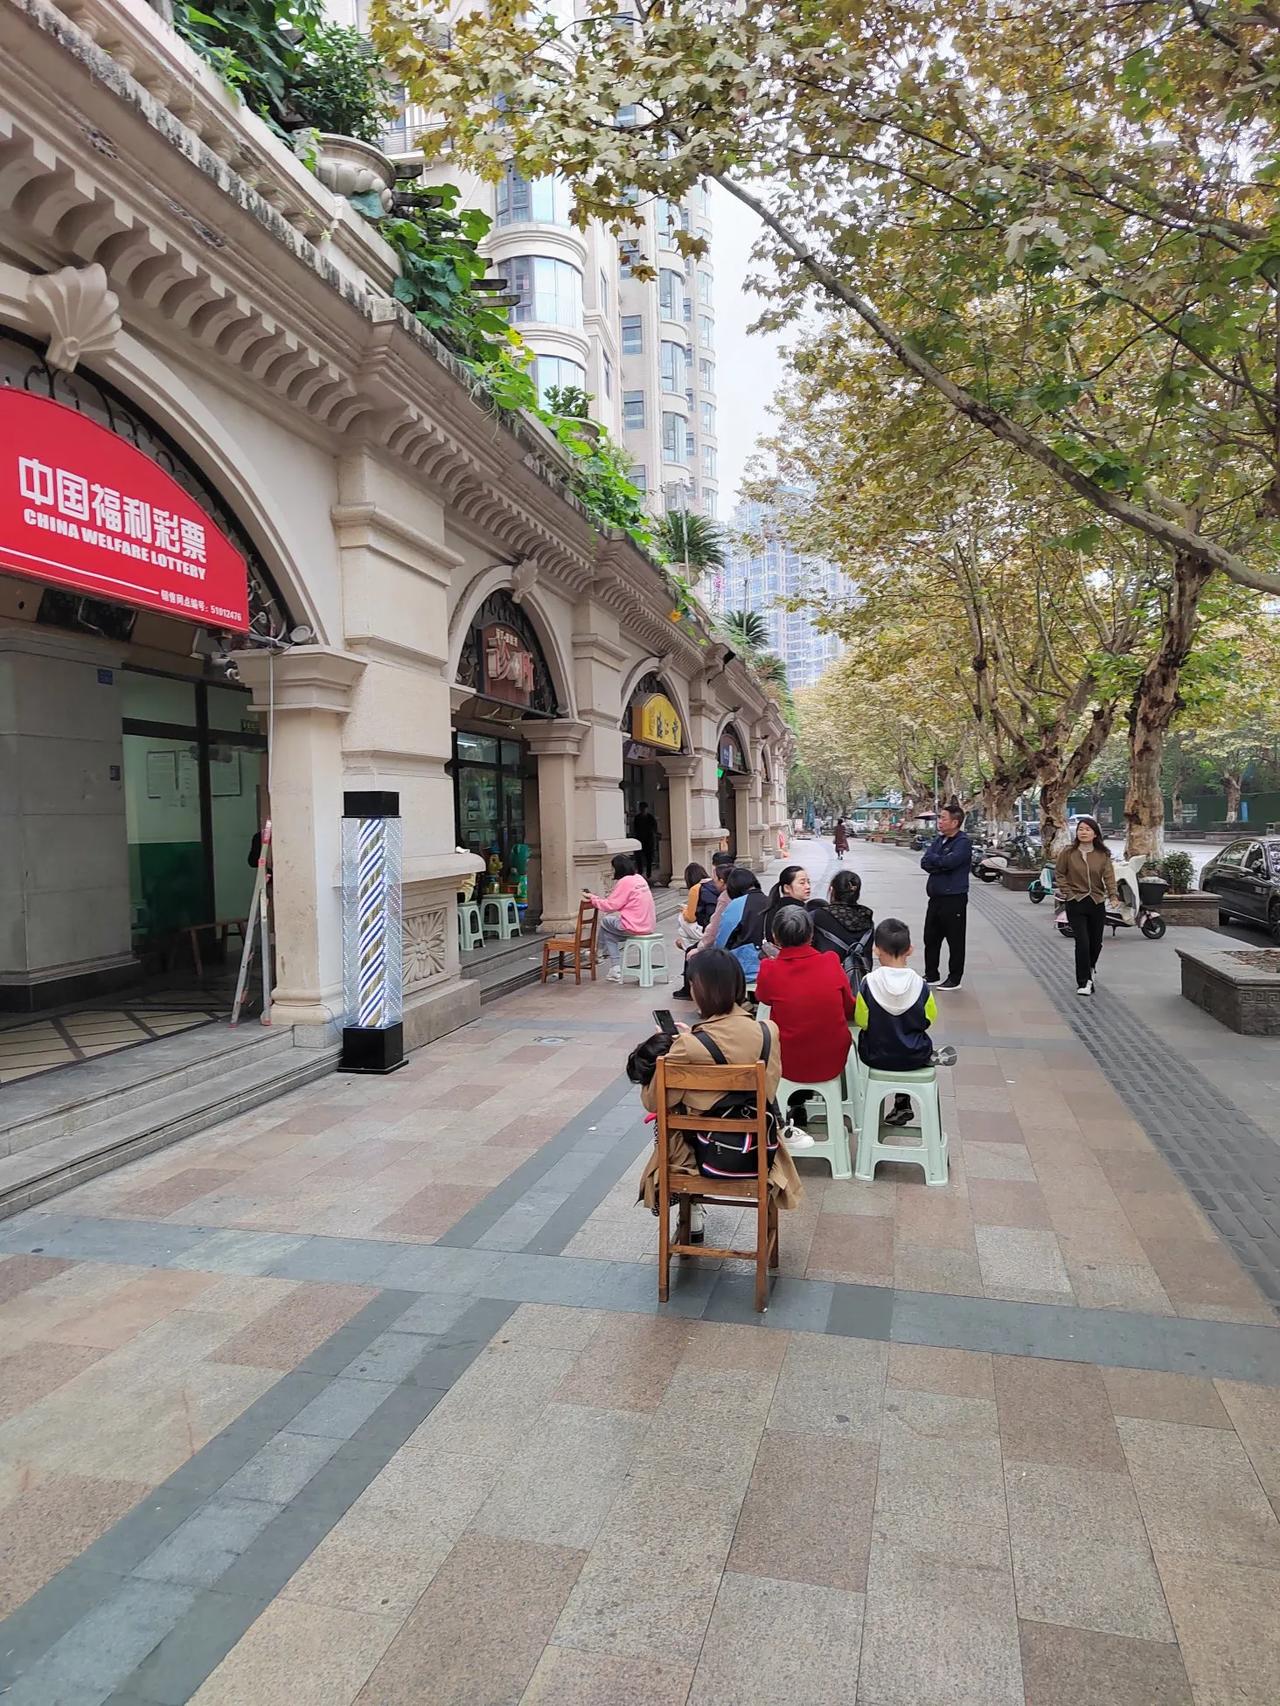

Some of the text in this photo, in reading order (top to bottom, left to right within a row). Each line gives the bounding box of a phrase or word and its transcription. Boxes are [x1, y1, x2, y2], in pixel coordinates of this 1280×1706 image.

[18, 456, 207, 563] 中国福利彩票
[24, 508, 207, 580] CHINA WELFARE LOTTERY
